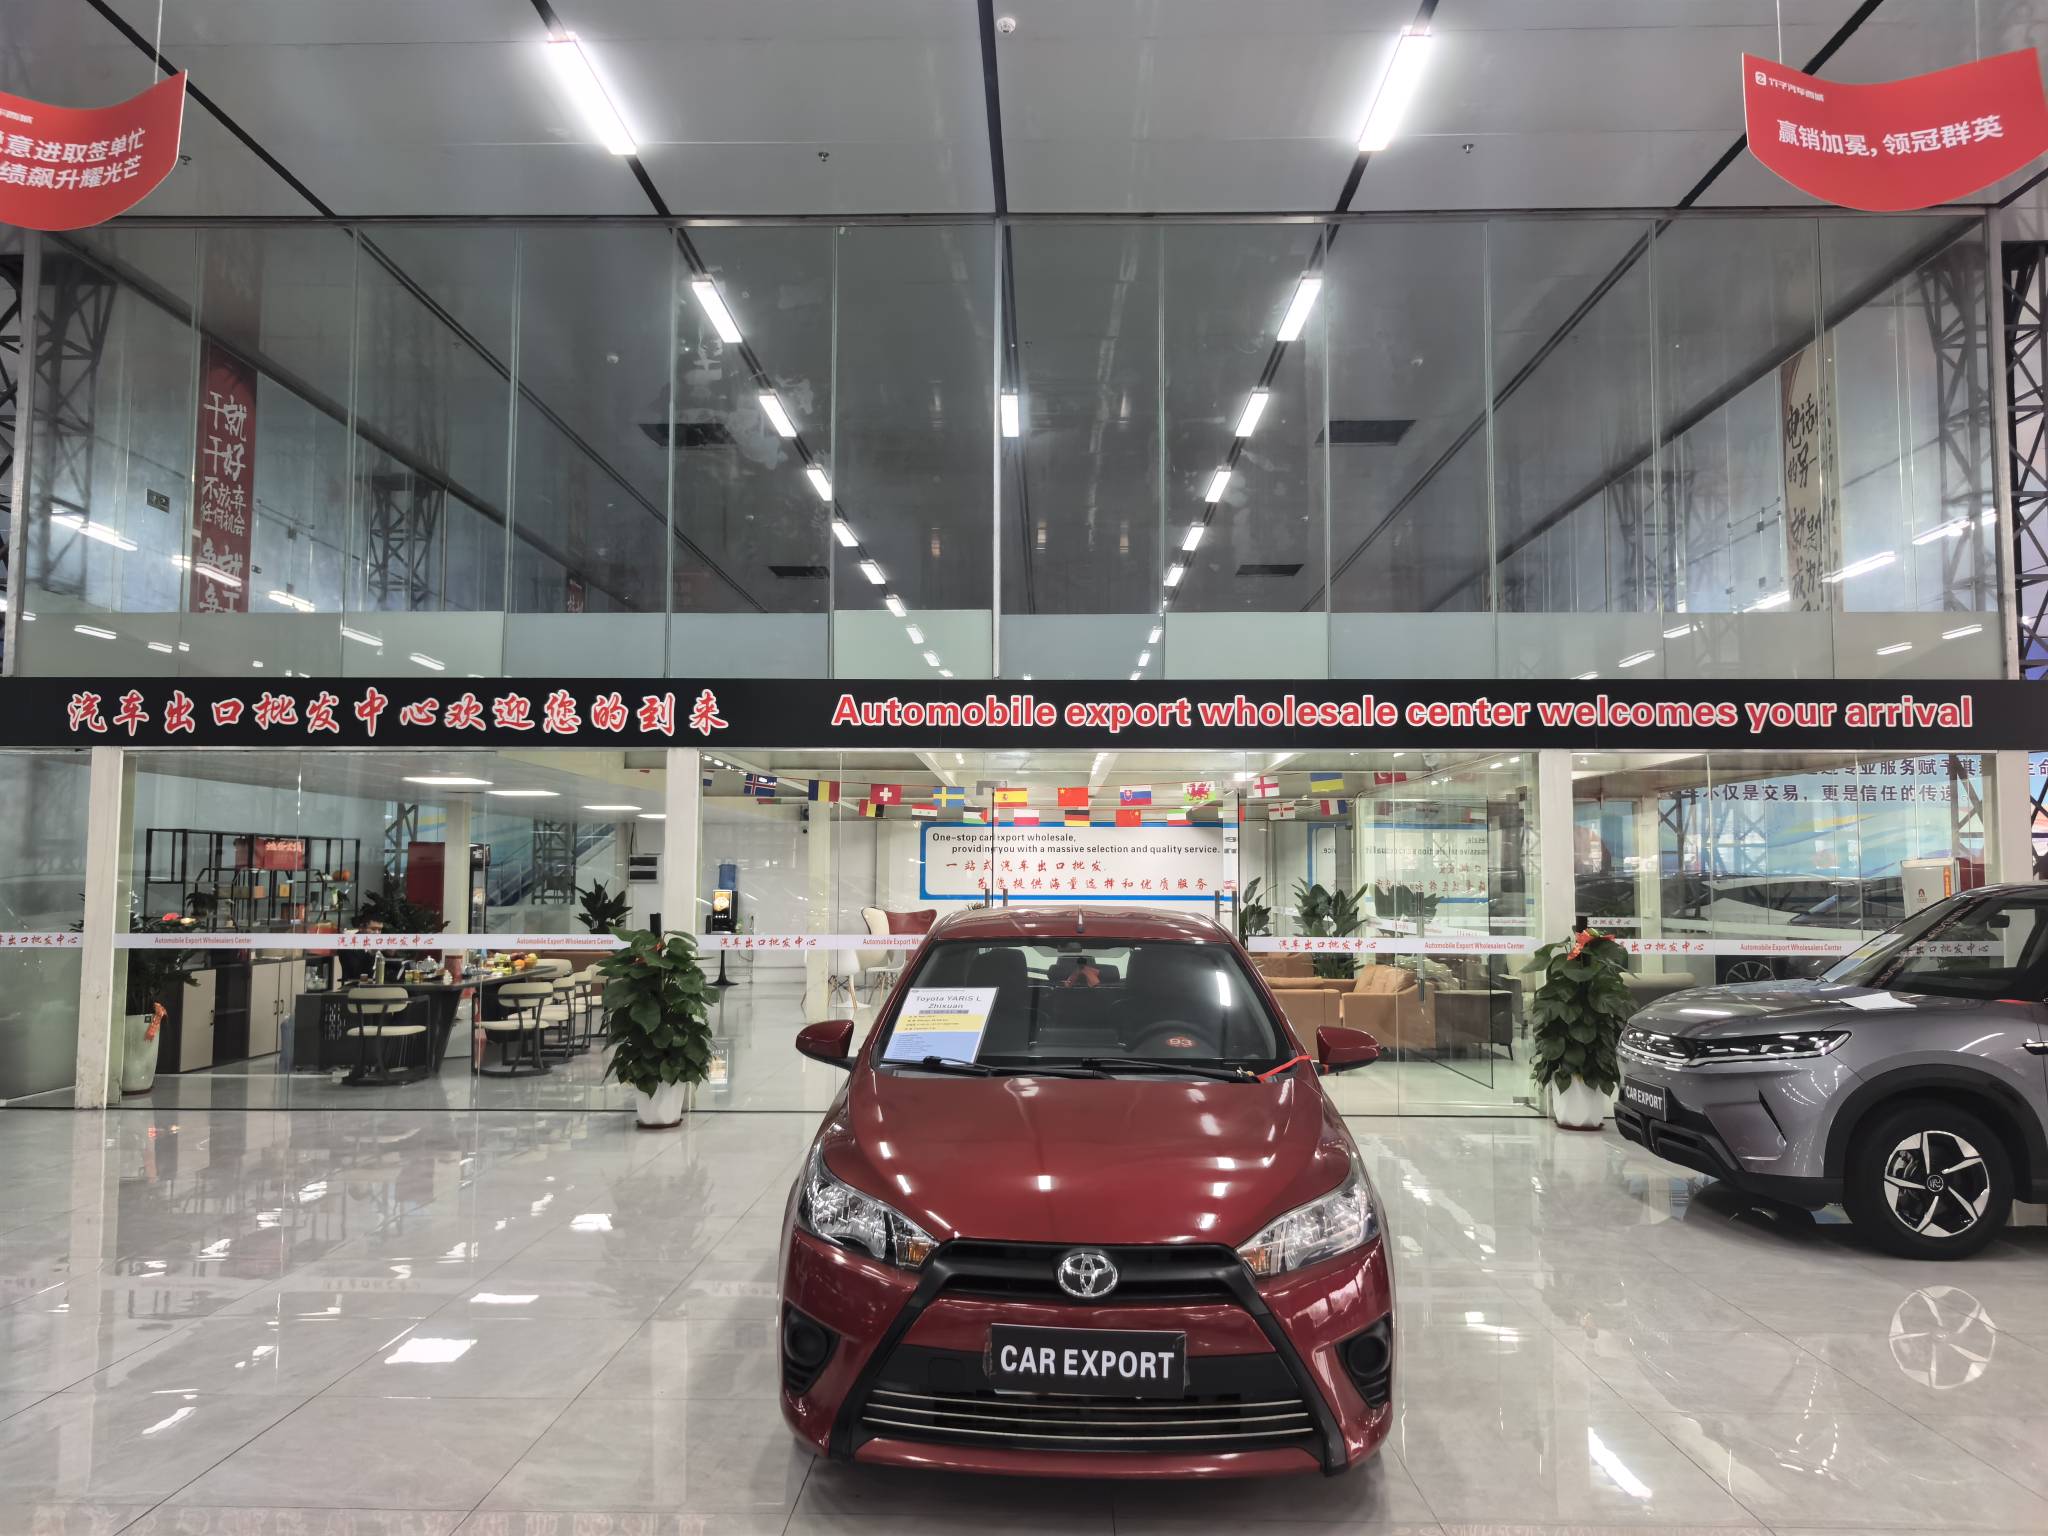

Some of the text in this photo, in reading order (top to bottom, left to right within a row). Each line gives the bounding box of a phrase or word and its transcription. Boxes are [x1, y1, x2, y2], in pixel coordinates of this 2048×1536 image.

[0, 128, 145, 163] 意进取签单忙
[1777, 115, 2004, 157] 赢销加冕，领冠群英
[68, 686, 730, 737] 汽车出口批发中心欢迎您的到来
[831, 694, 1974, 735] Automobile export wholesale center welcomes your arrival
[933, 833, 977, 842] One-stop
[1027, 833, 1076, 843] wholesale,
[1017, 845, 1038, 853] with
[1087, 845, 1129, 853] selection
[1131, 845, 1148, 853] and
[1150, 845, 1182, 855] quality
[1184, 846, 1221, 854] service.
[1625, 1085, 1662, 1111] CAR EXPORT
[1000, 1344, 1174, 1379] CAR EXPORT
